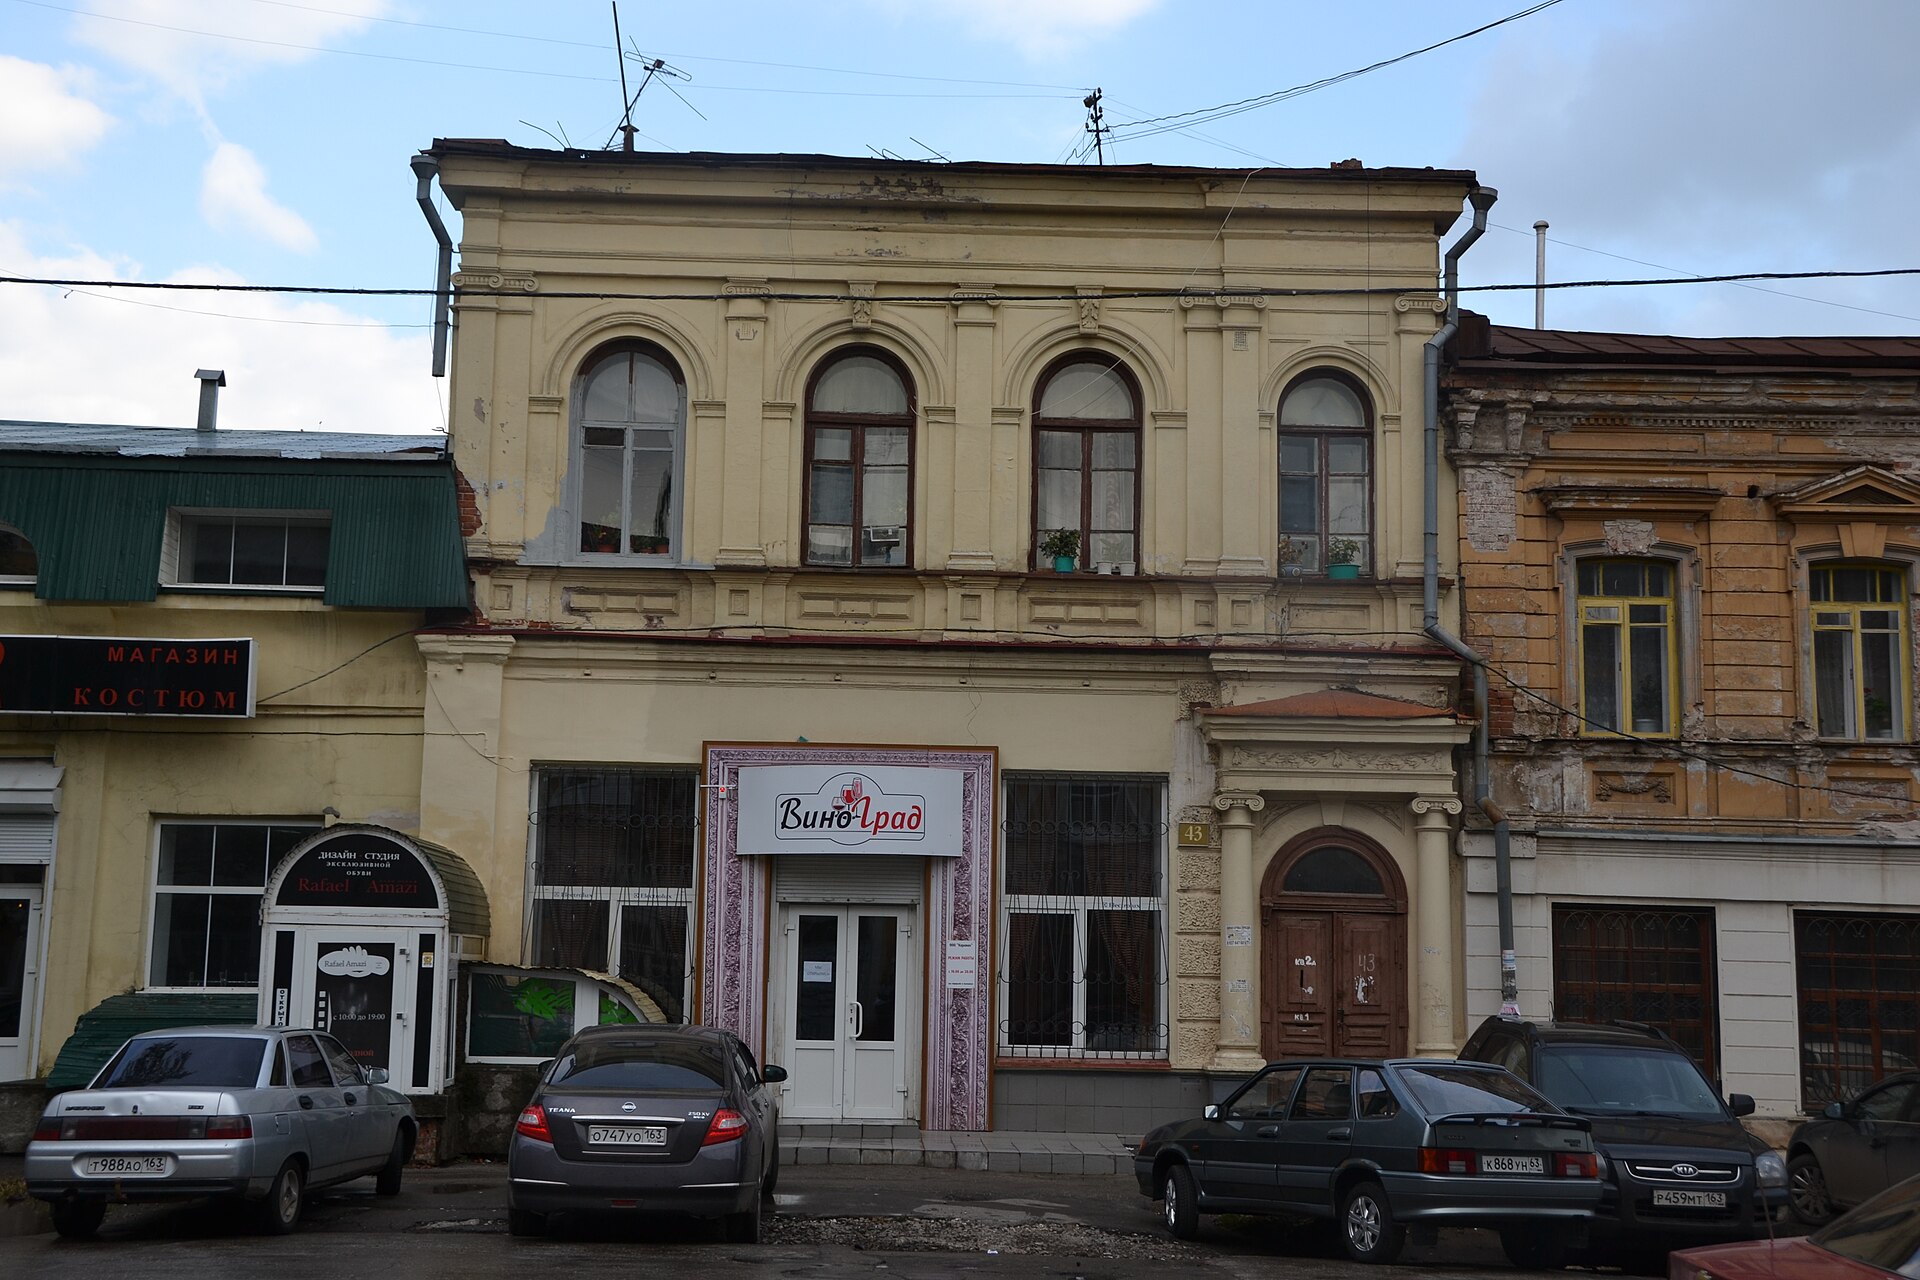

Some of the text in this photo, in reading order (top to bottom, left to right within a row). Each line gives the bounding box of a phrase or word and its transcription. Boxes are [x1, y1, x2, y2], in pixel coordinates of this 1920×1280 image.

[107, 646, 238, 664] МАГАЗИН
[73, 687, 237, 709] КОСТЮМ
[1184, 825, 1203, 841] 43
[318, 850, 400, 861] ДИЗАЙН СТУДИЯ
[298, 877, 418, 894] Rafael Amazi
[324, 960, 345, 968] Rafael
[1358, 953, 1375, 972] 43
[644, 1130, 662, 1140] 163
[144, 1158, 162, 1168] 163
[1530, 1158, 1540, 1168] 63
[1676, 1166, 1694, 1174] KIA
[1705, 1193, 1722, 1203] 163
